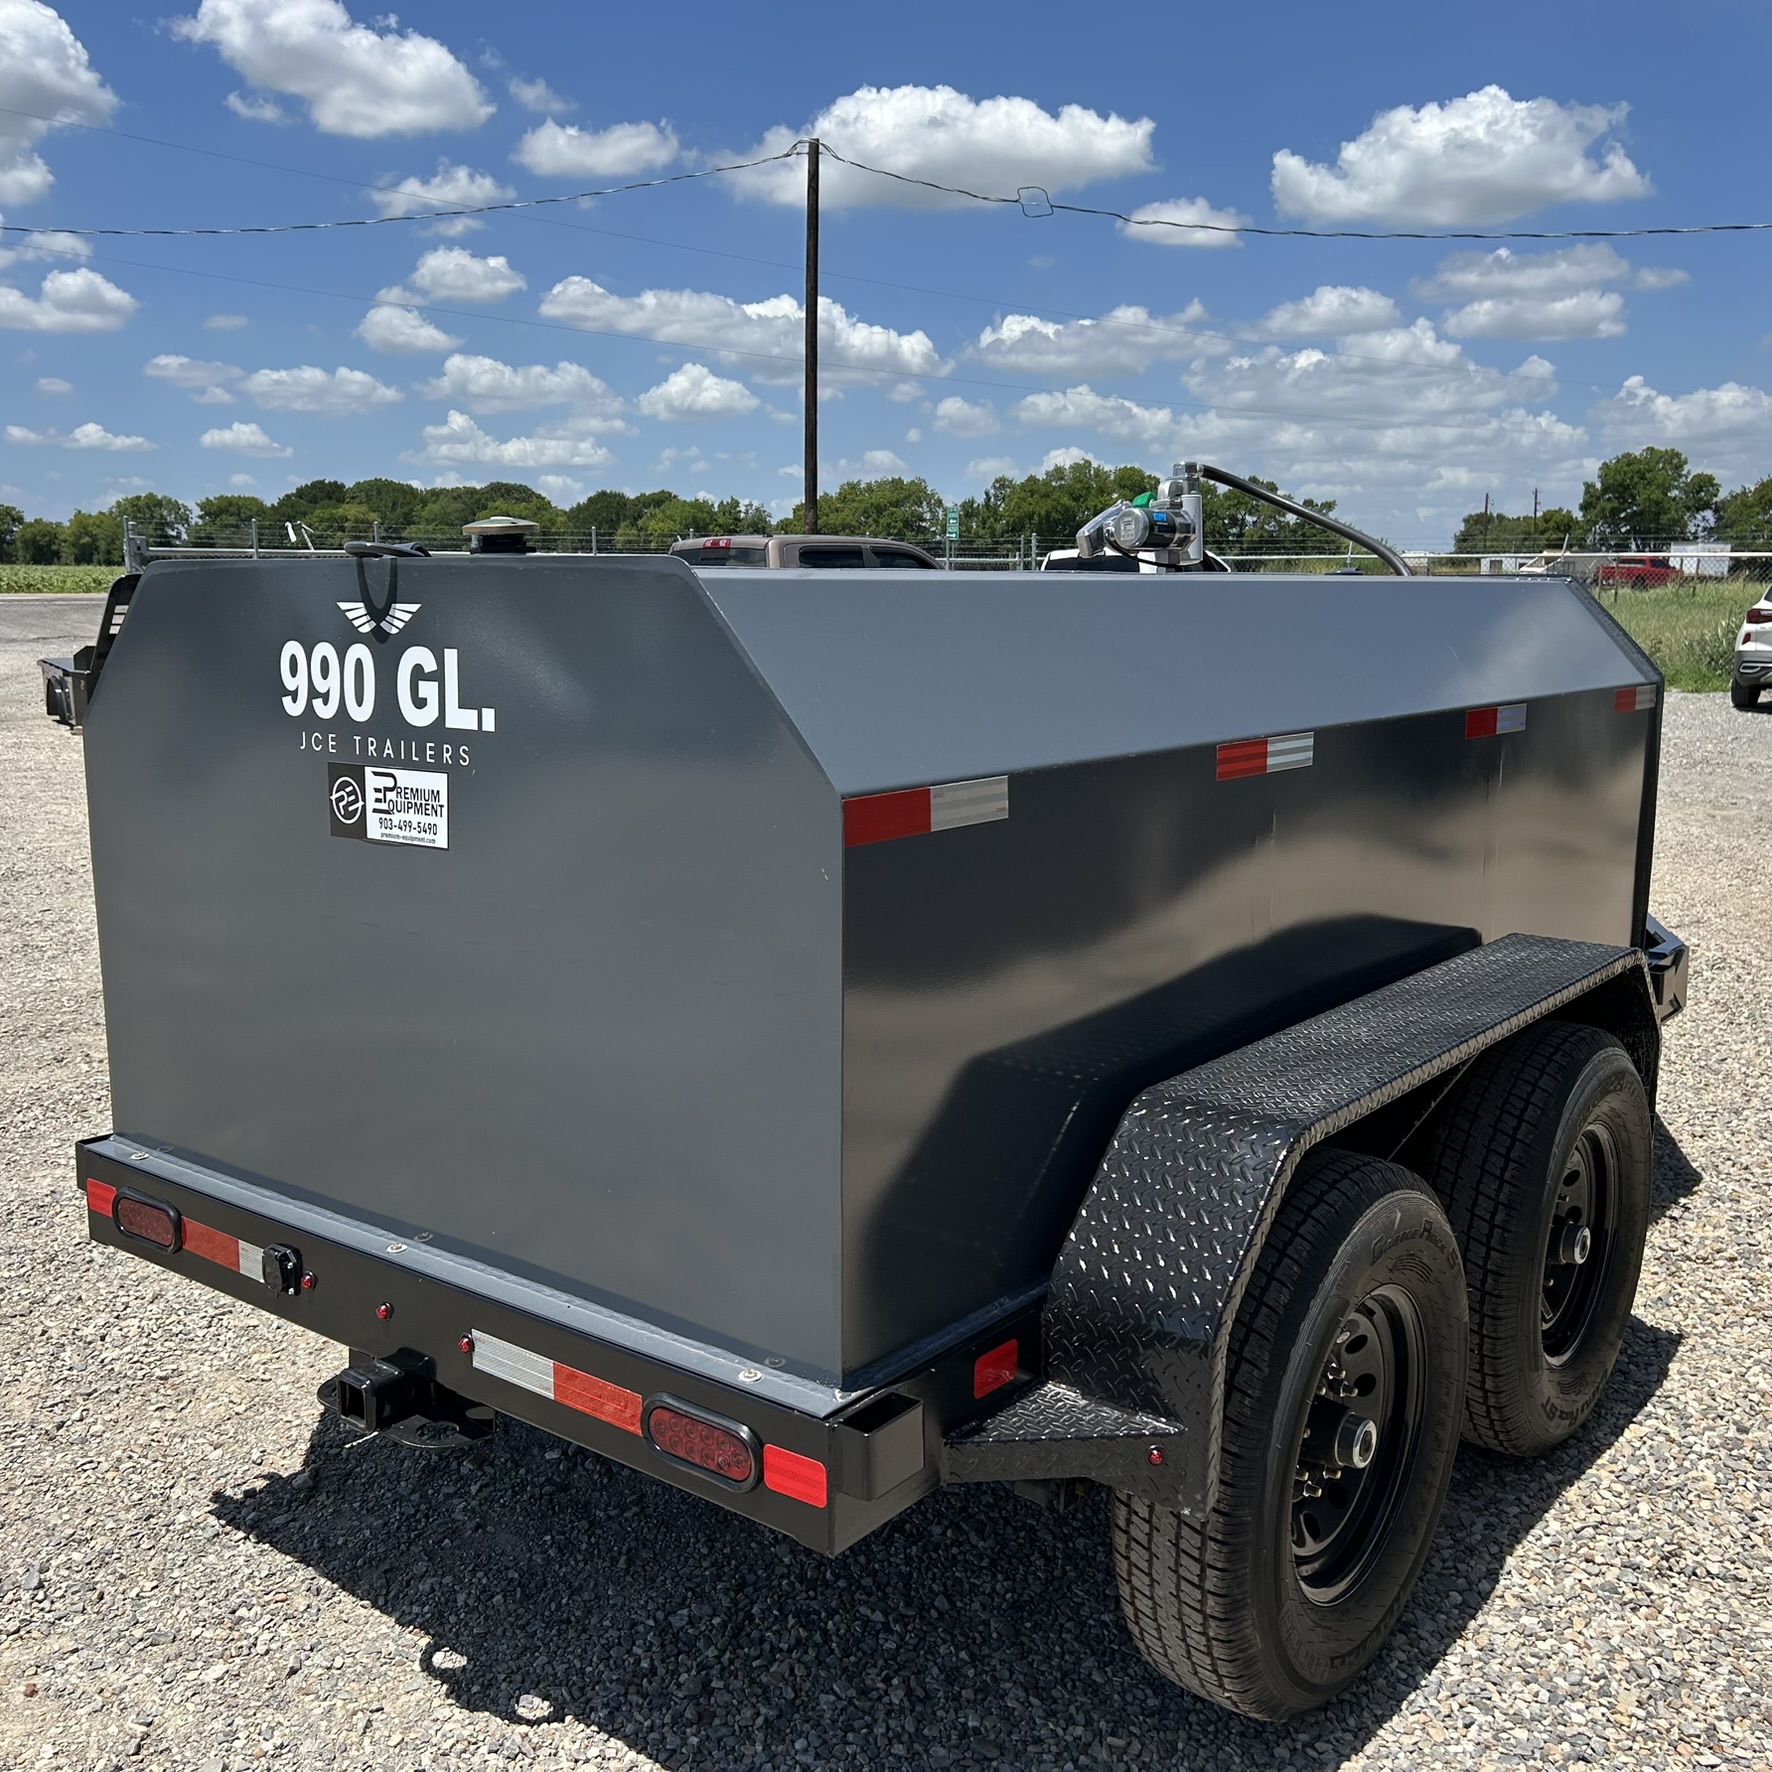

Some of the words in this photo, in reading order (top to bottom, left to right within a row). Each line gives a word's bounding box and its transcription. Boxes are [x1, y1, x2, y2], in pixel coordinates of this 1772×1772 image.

[280, 640, 376, 722] 990
[396, 645, 495, 732] GL.
[300, 731, 337, 753] JCE
[353, 735, 470, 766] TRAILERS
[378, 817, 438, 836] 903-499-5490
[380, 832, 436, 844] premium-equipment.com
